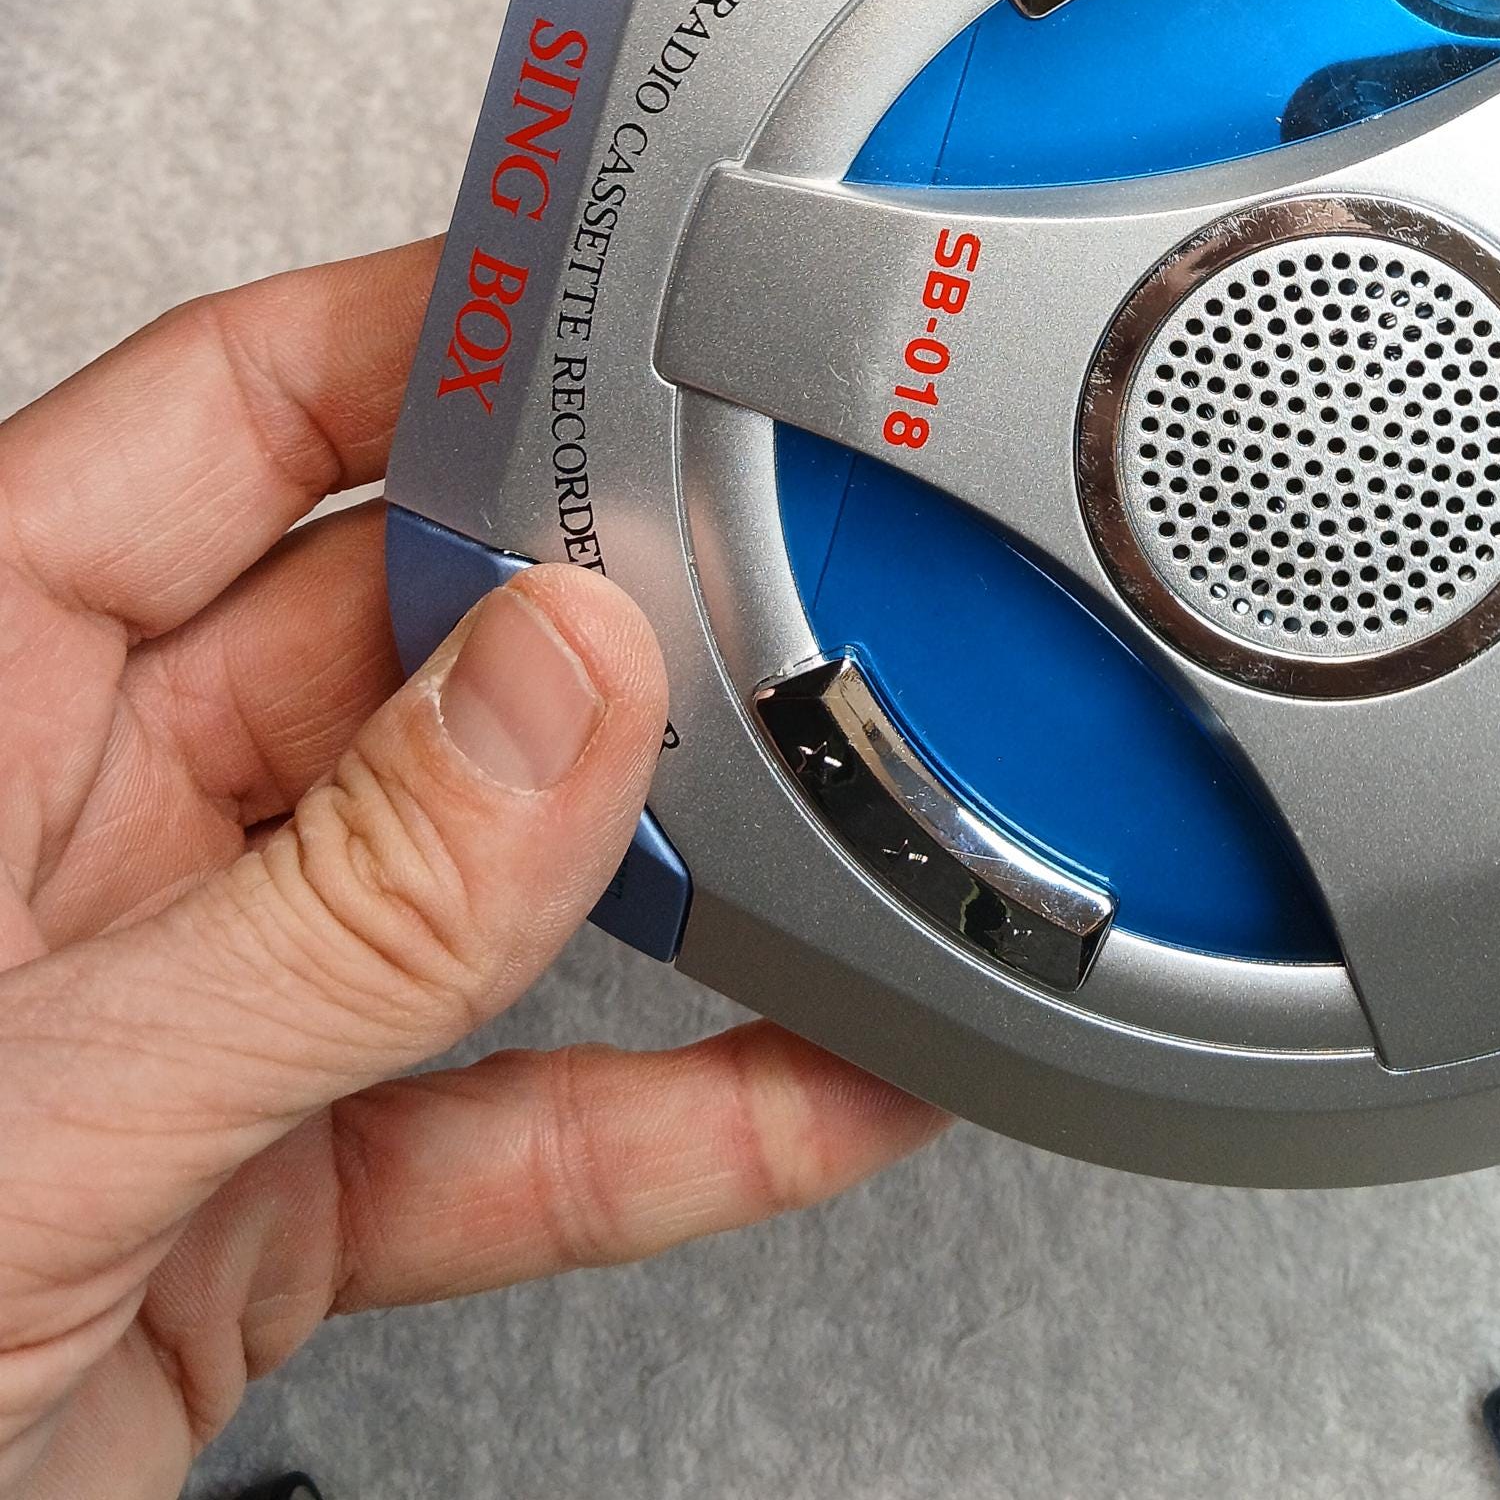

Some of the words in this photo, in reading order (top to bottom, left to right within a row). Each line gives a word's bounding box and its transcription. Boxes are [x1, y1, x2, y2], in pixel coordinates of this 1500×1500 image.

[490, 17, 589, 223] SING
[437, 246, 530, 417] BOX
[554, 122, 649, 342] CASSETTE
[883, 228, 982, 450] SB-018
[550, 352, 607, 578] RECORDE
